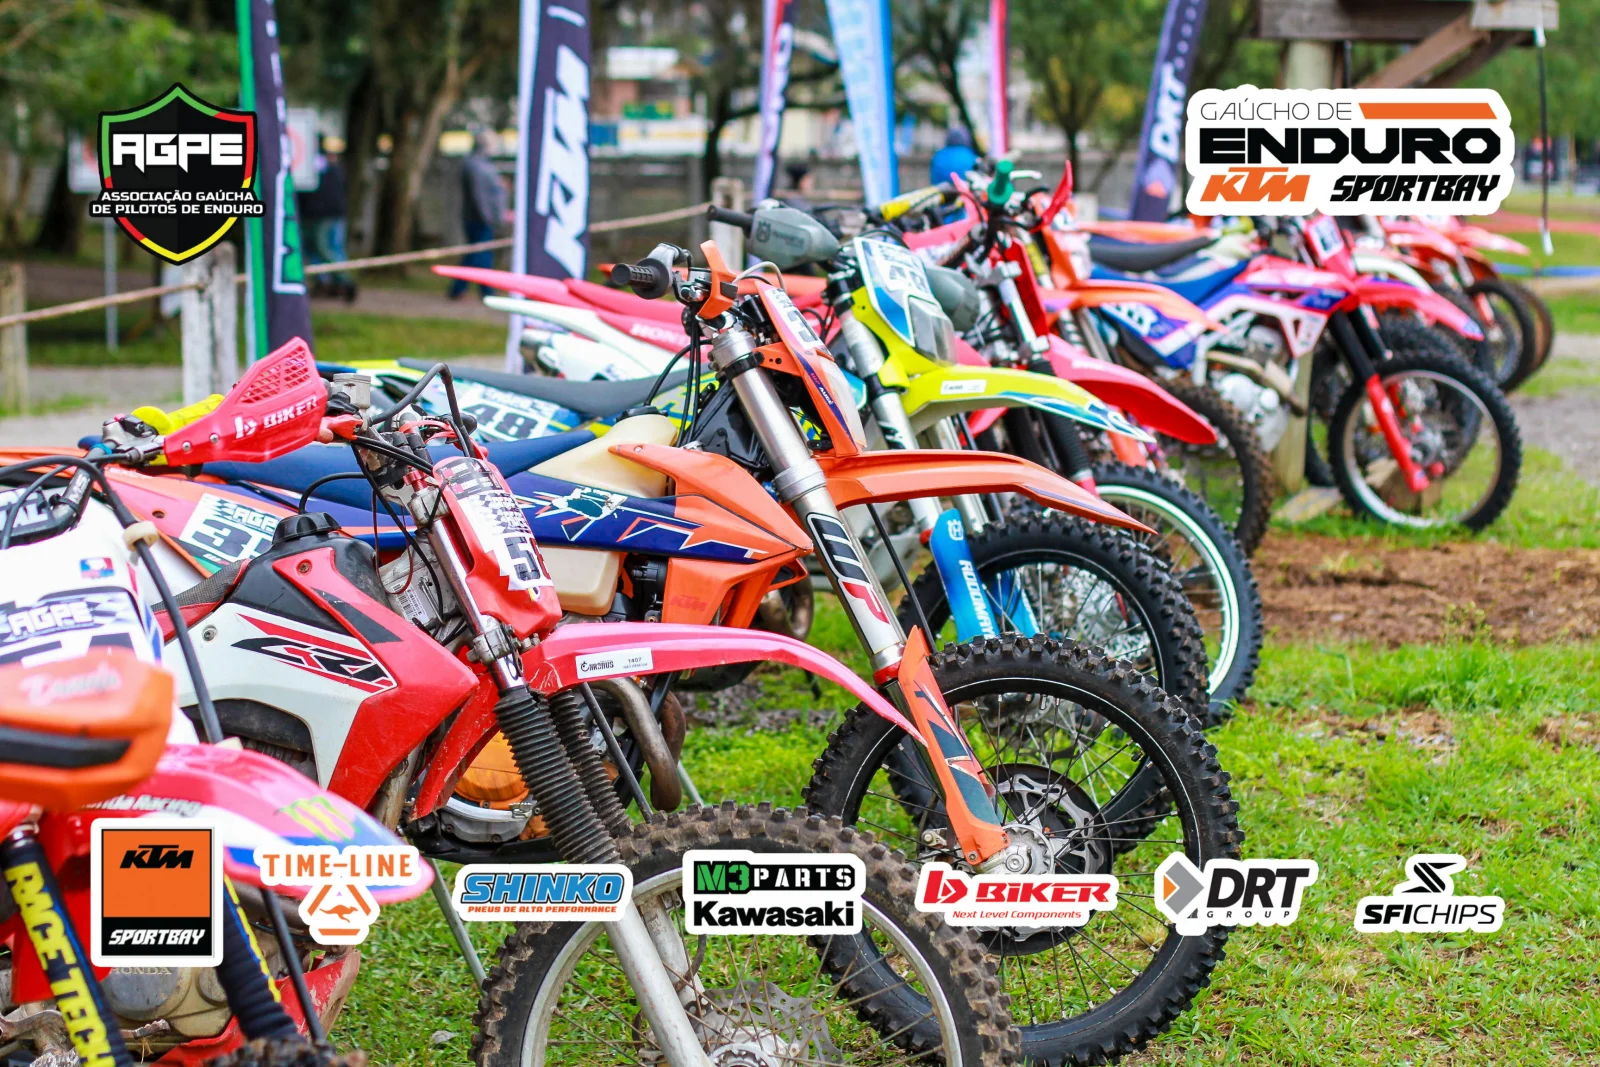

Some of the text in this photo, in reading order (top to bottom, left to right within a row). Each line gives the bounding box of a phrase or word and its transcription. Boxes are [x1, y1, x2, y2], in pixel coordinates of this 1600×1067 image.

[535, 44, 591, 283] KTM
[629, 322, 692, 347] HOND
[462, 403, 538, 439] 48
[231, 505, 279, 534] AGP
[7, 600, 94, 637] AGPE
[4, 861, 78, 971] RACE
